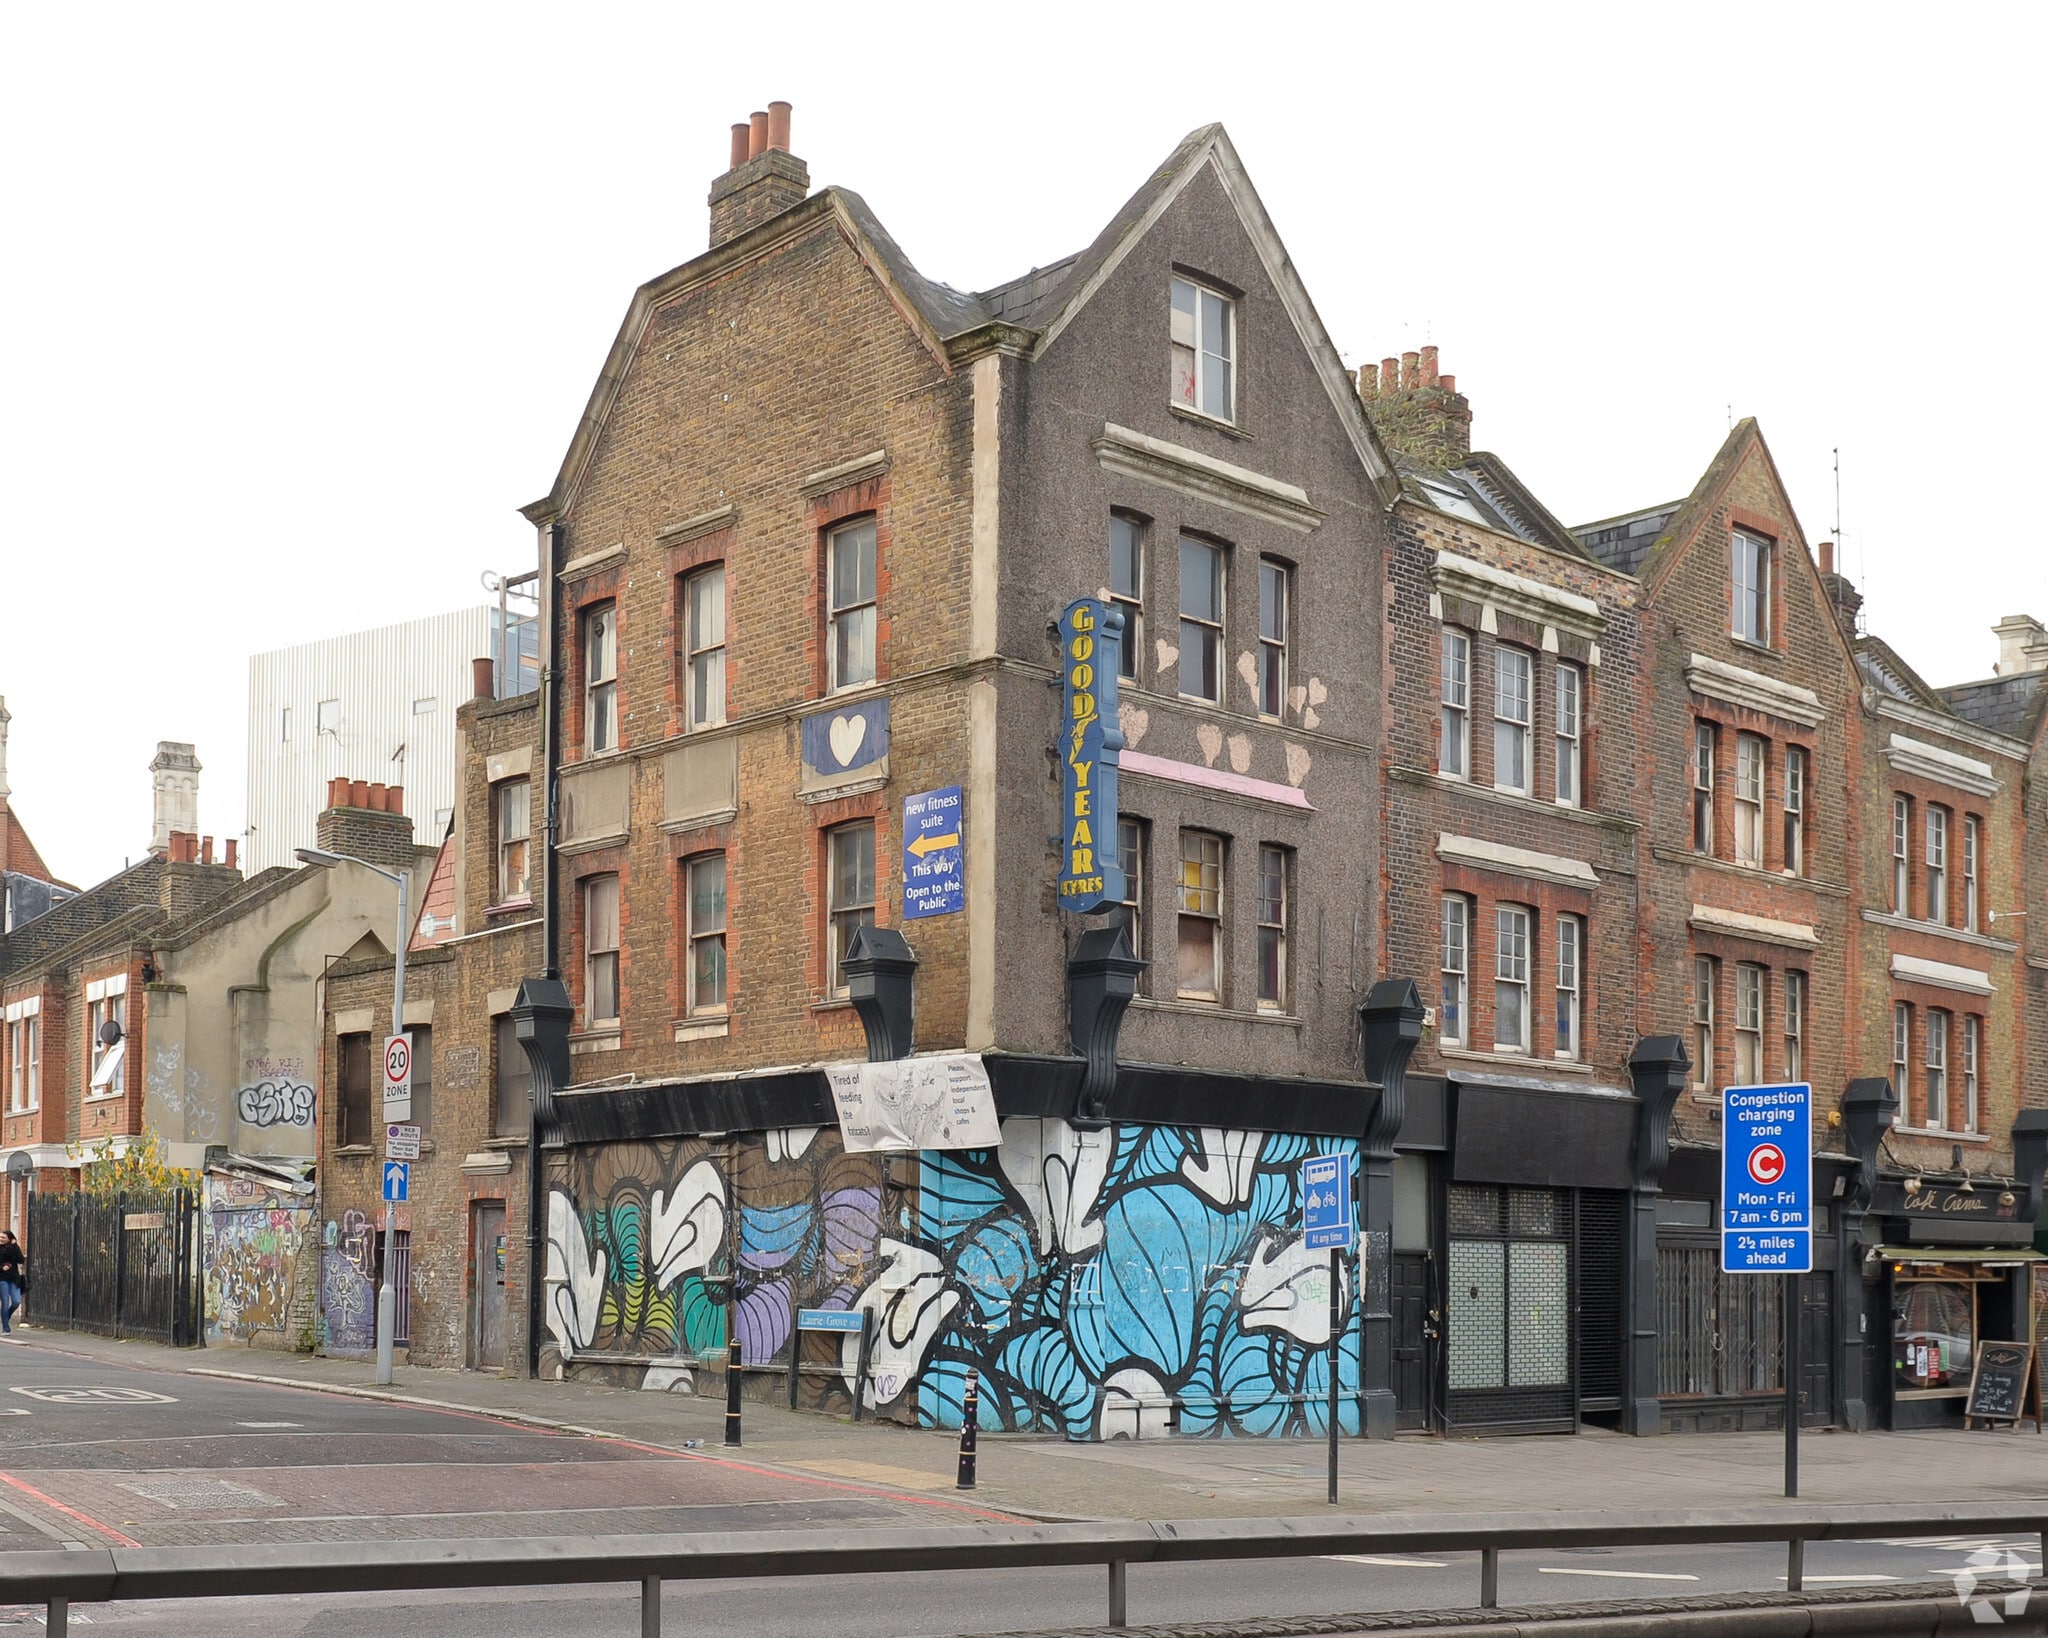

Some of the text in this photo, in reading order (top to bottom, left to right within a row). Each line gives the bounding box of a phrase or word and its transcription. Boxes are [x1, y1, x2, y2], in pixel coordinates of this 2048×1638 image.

[906, 795, 958, 816] new fitness
[920, 814, 944, 829] suite
[911, 865, 932, 878] This
[906, 880, 960, 901] Open to the
[1061, 876, 1104, 896] TYRES
[918, 896, 947, 911] Public
[389, 1050, 407, 1069] 20
[833, 1072, 860, 1086] Tired of
[949, 1074, 972, 1084] support
[386, 1084, 408, 1097] ZONE
[950, 1083, 987, 1094] independent
[838, 1092, 862, 1104] feeding
[952, 1096, 966, 1104] local
[1729, 1091, 1805, 1108] Congestion
[953, 1105, 976, 1116] shops &
[1738, 1108, 1795, 1123] charging
[1750, 1125, 1782, 1137] zone
[1738, 1192, 1767, 1206] Mon
[1777, 1191, 1796, 1204] Fri
[1308, 1213, 1318, 1223] taxi
[1312, 1232, 1342, 1244] At any time
[1759, 1236, 1795, 1249] miles
[1746, 1251, 1787, 1265] ahead
[801, 1314, 824, 1326] Laurie
[826, 1315, 848, 1327] Grove
[35, 1389, 153, 1401] 20
